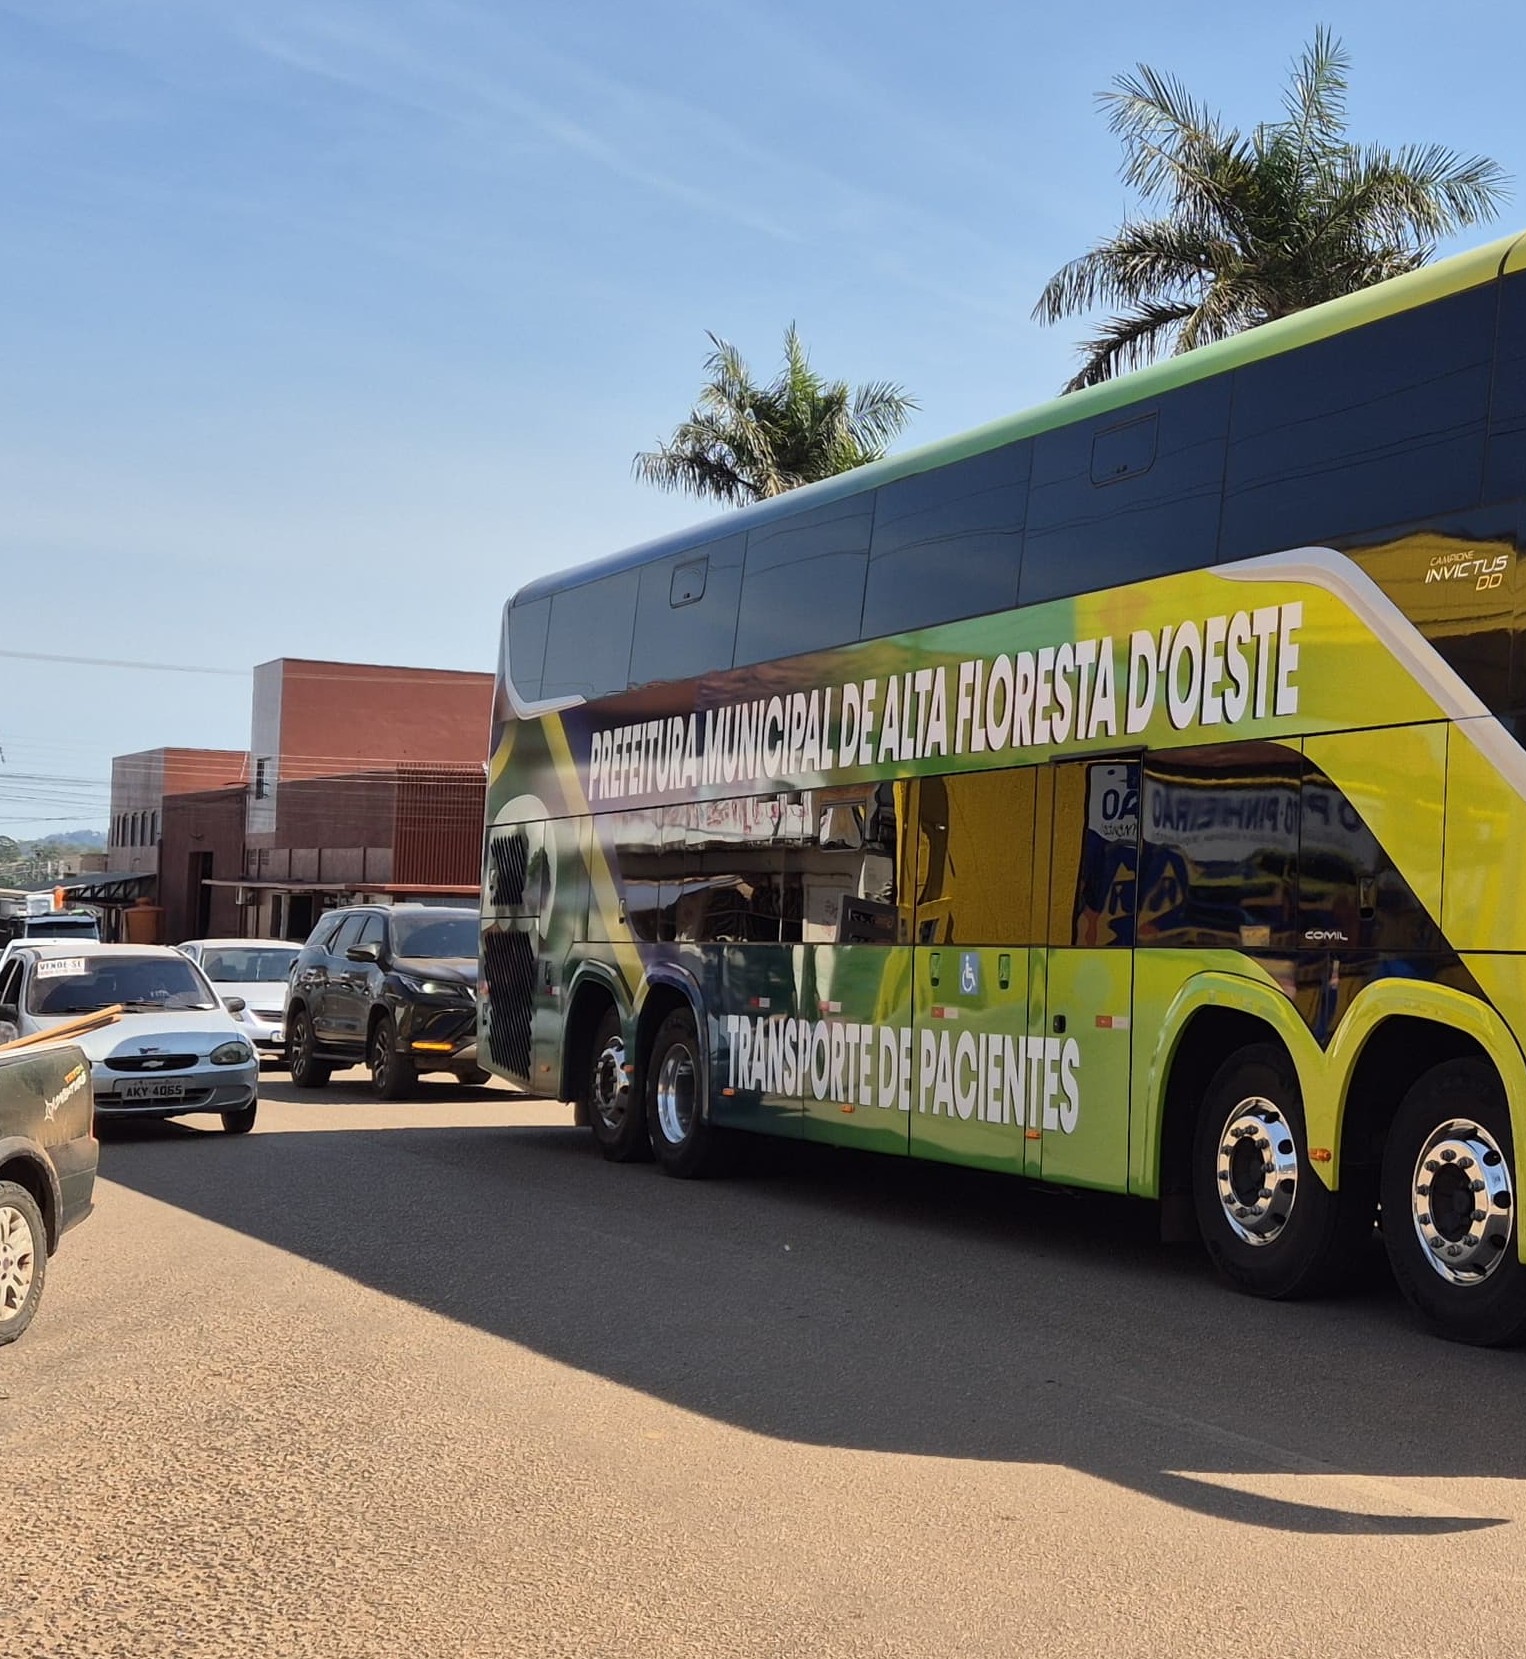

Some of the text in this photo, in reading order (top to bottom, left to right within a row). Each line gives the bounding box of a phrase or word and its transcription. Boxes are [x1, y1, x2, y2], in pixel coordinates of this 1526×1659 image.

[1425, 555, 1508, 584] INVICTUS
[1476, 573, 1503, 591] DD
[588, 601, 1303, 801] PREFEITURA MUNICIPAL DE ALTA FLORESTA D'OESTE
[1304, 930, 1349, 941] COMIL
[727, 1014, 1081, 1135] TRANSPORTE DE PACIENTES
